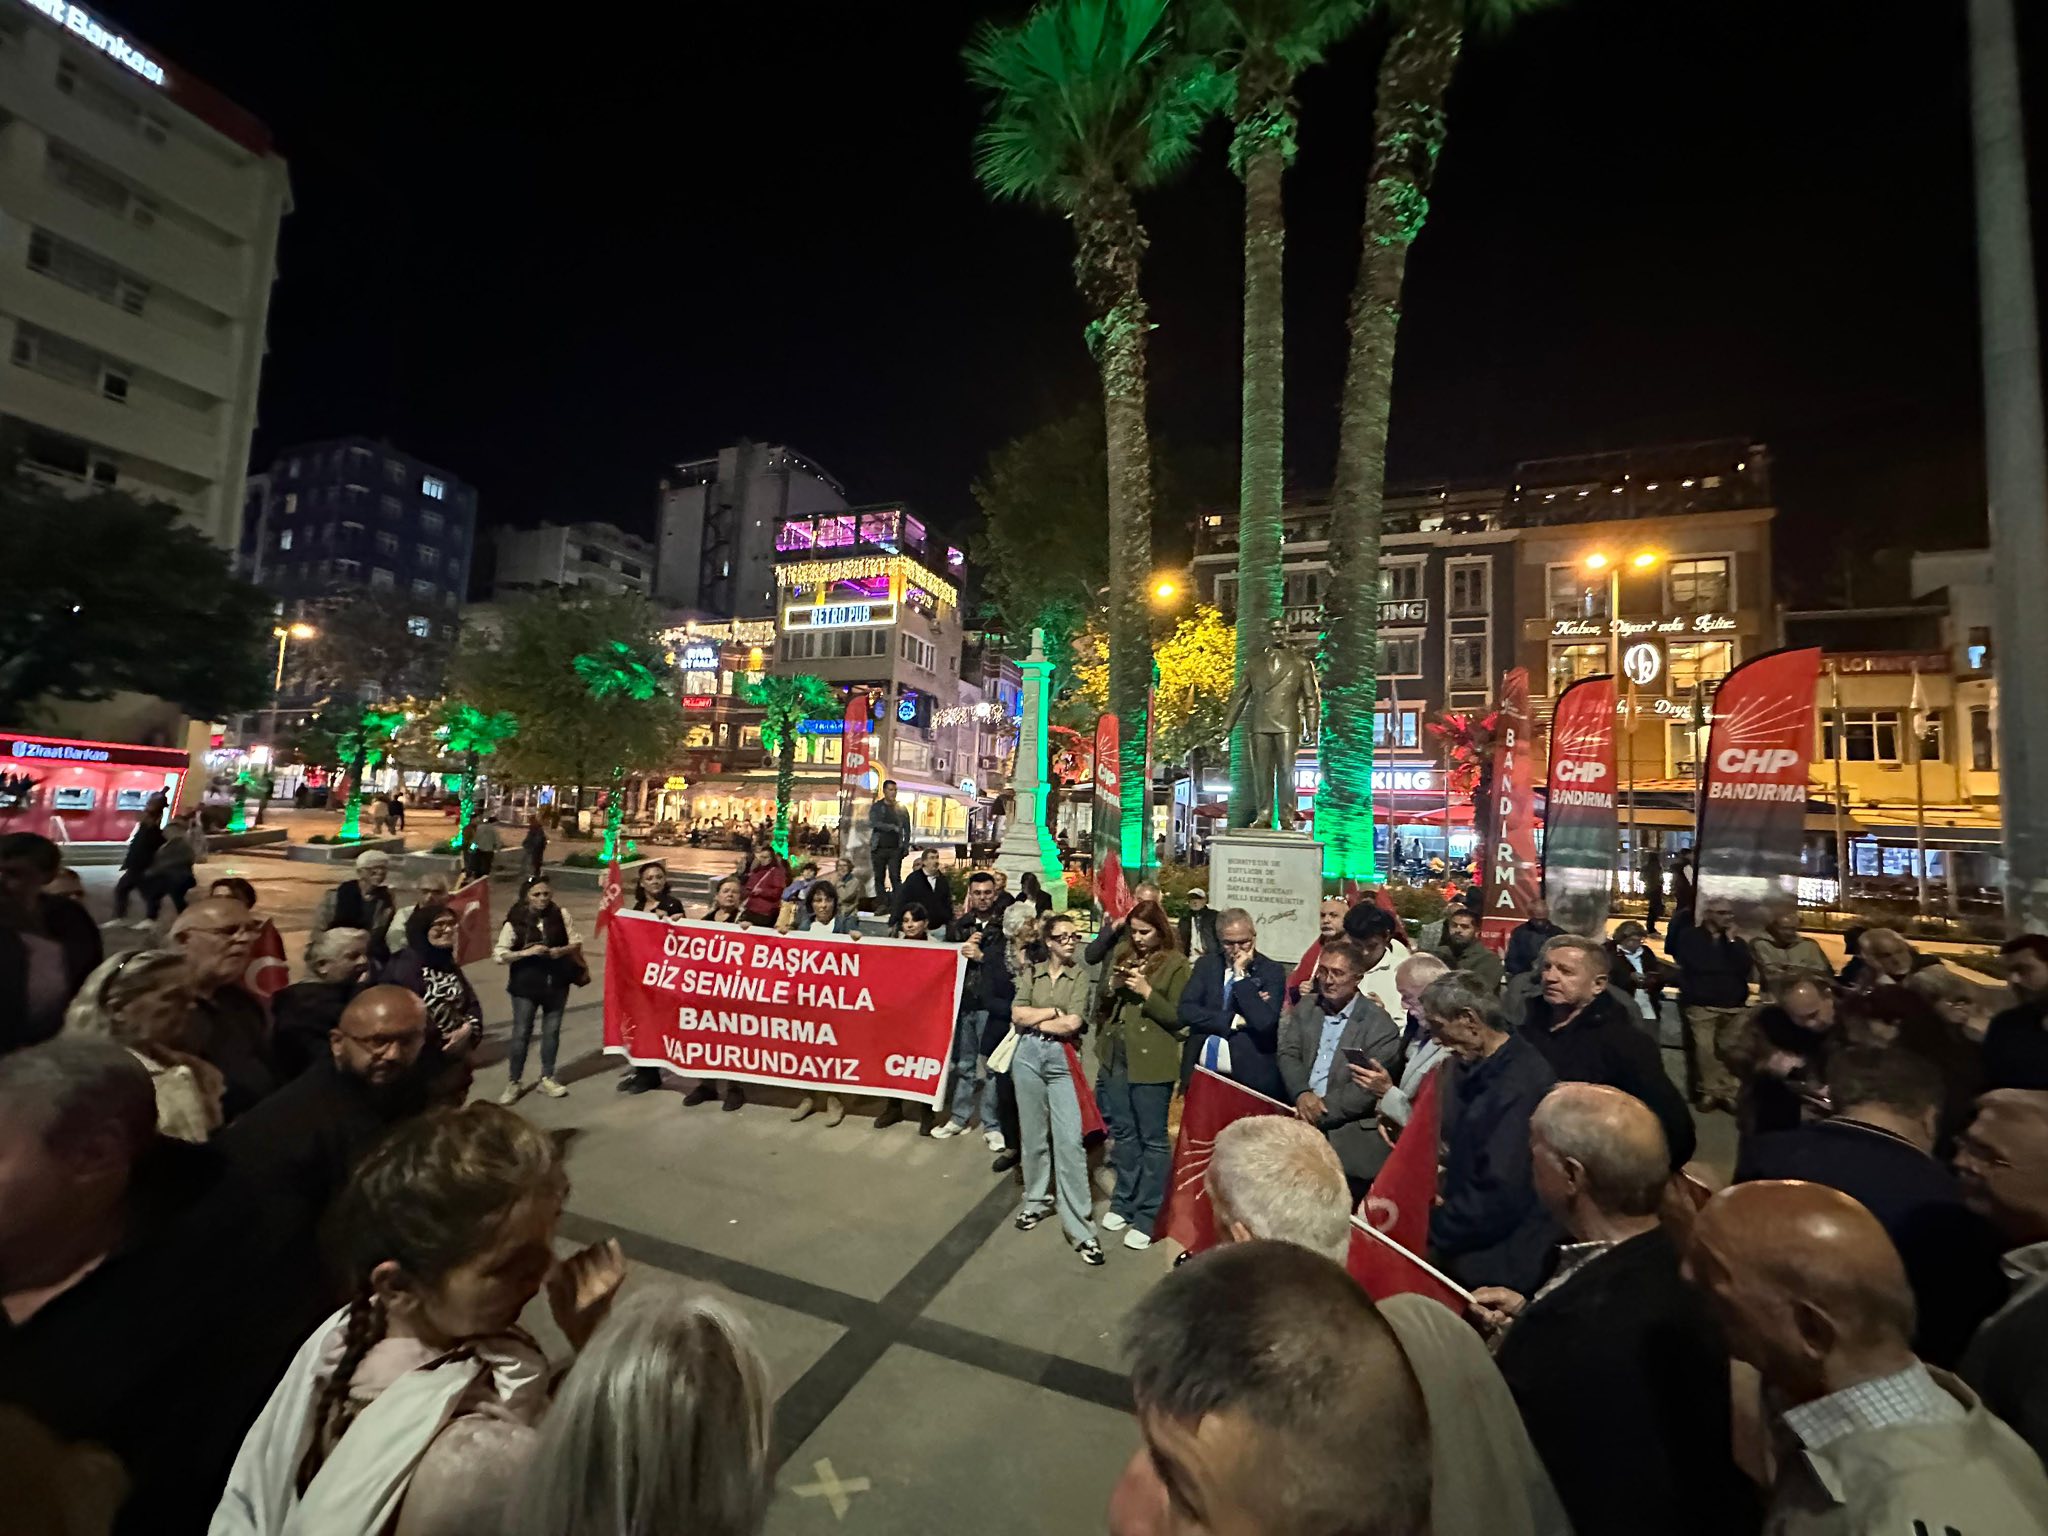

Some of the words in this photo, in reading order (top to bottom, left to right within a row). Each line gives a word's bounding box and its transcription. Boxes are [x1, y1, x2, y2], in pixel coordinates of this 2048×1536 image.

[65, 5, 164, 85] Bankası
[811, 607, 847, 626] RETRO
[848, 605, 871, 623] PUB
[1555, 759, 1607, 783] CHP
[1717, 747, 1799, 774] CHP
[1371, 770, 1432, 791] KING
[1709, 781, 1807, 803] BANDIRMA
[1550, 788, 1614, 809] BANDIRMA
[1495, 728, 1516, 909] BANDIRMA
[663, 929, 745, 967] ÖZGÜR
[751, 943, 860, 978] BAŞKAN
[642, 959, 677, 991] BİZ
[680, 967, 789, 1005] SENİNLE
[797, 983, 875, 1012] HALA
[678, 1007, 839, 1046] BANDIRMA
[662, 1034, 861, 1081] VAPURUNDAYIZ
[884, 1054, 942, 1081] CHP
